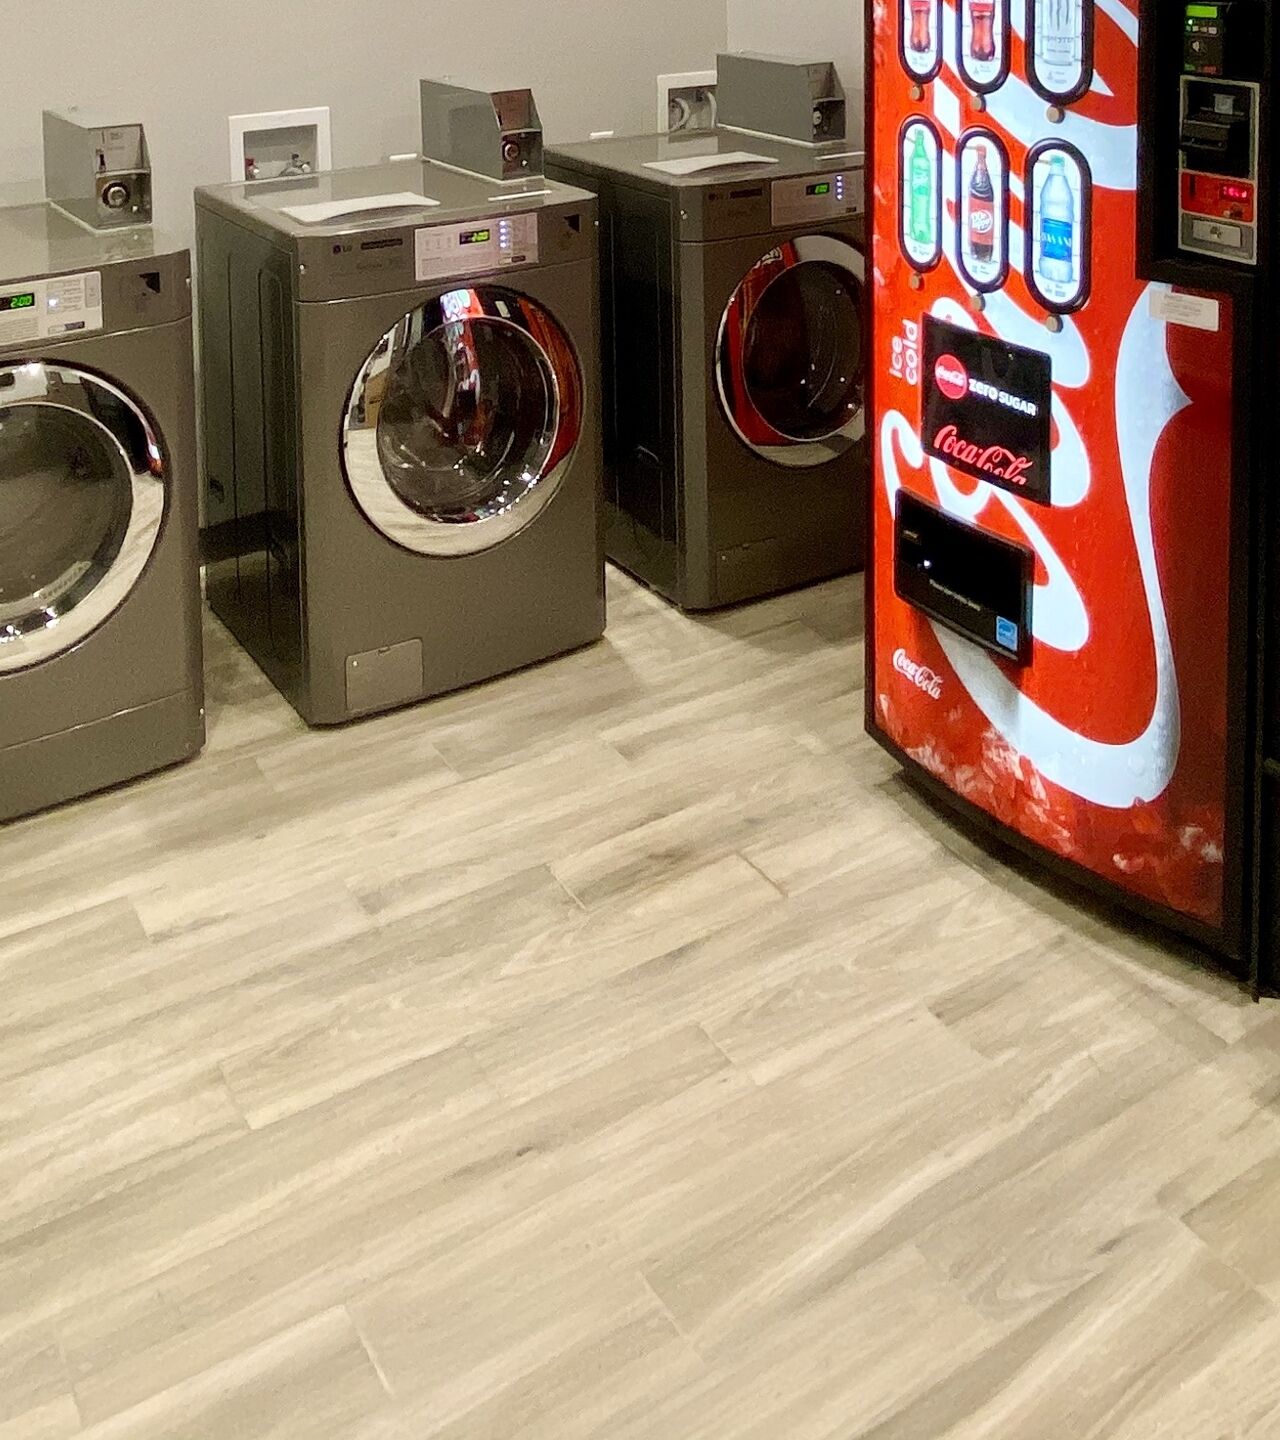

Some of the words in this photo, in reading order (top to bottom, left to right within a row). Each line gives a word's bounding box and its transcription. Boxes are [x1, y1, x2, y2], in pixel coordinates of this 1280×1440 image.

[889, 335, 903, 379] Ice
[902, 319, 918, 385] cold
[998, 389, 1037, 417] SUGAR
[892, 647, 943, 700] Coca-Cola
